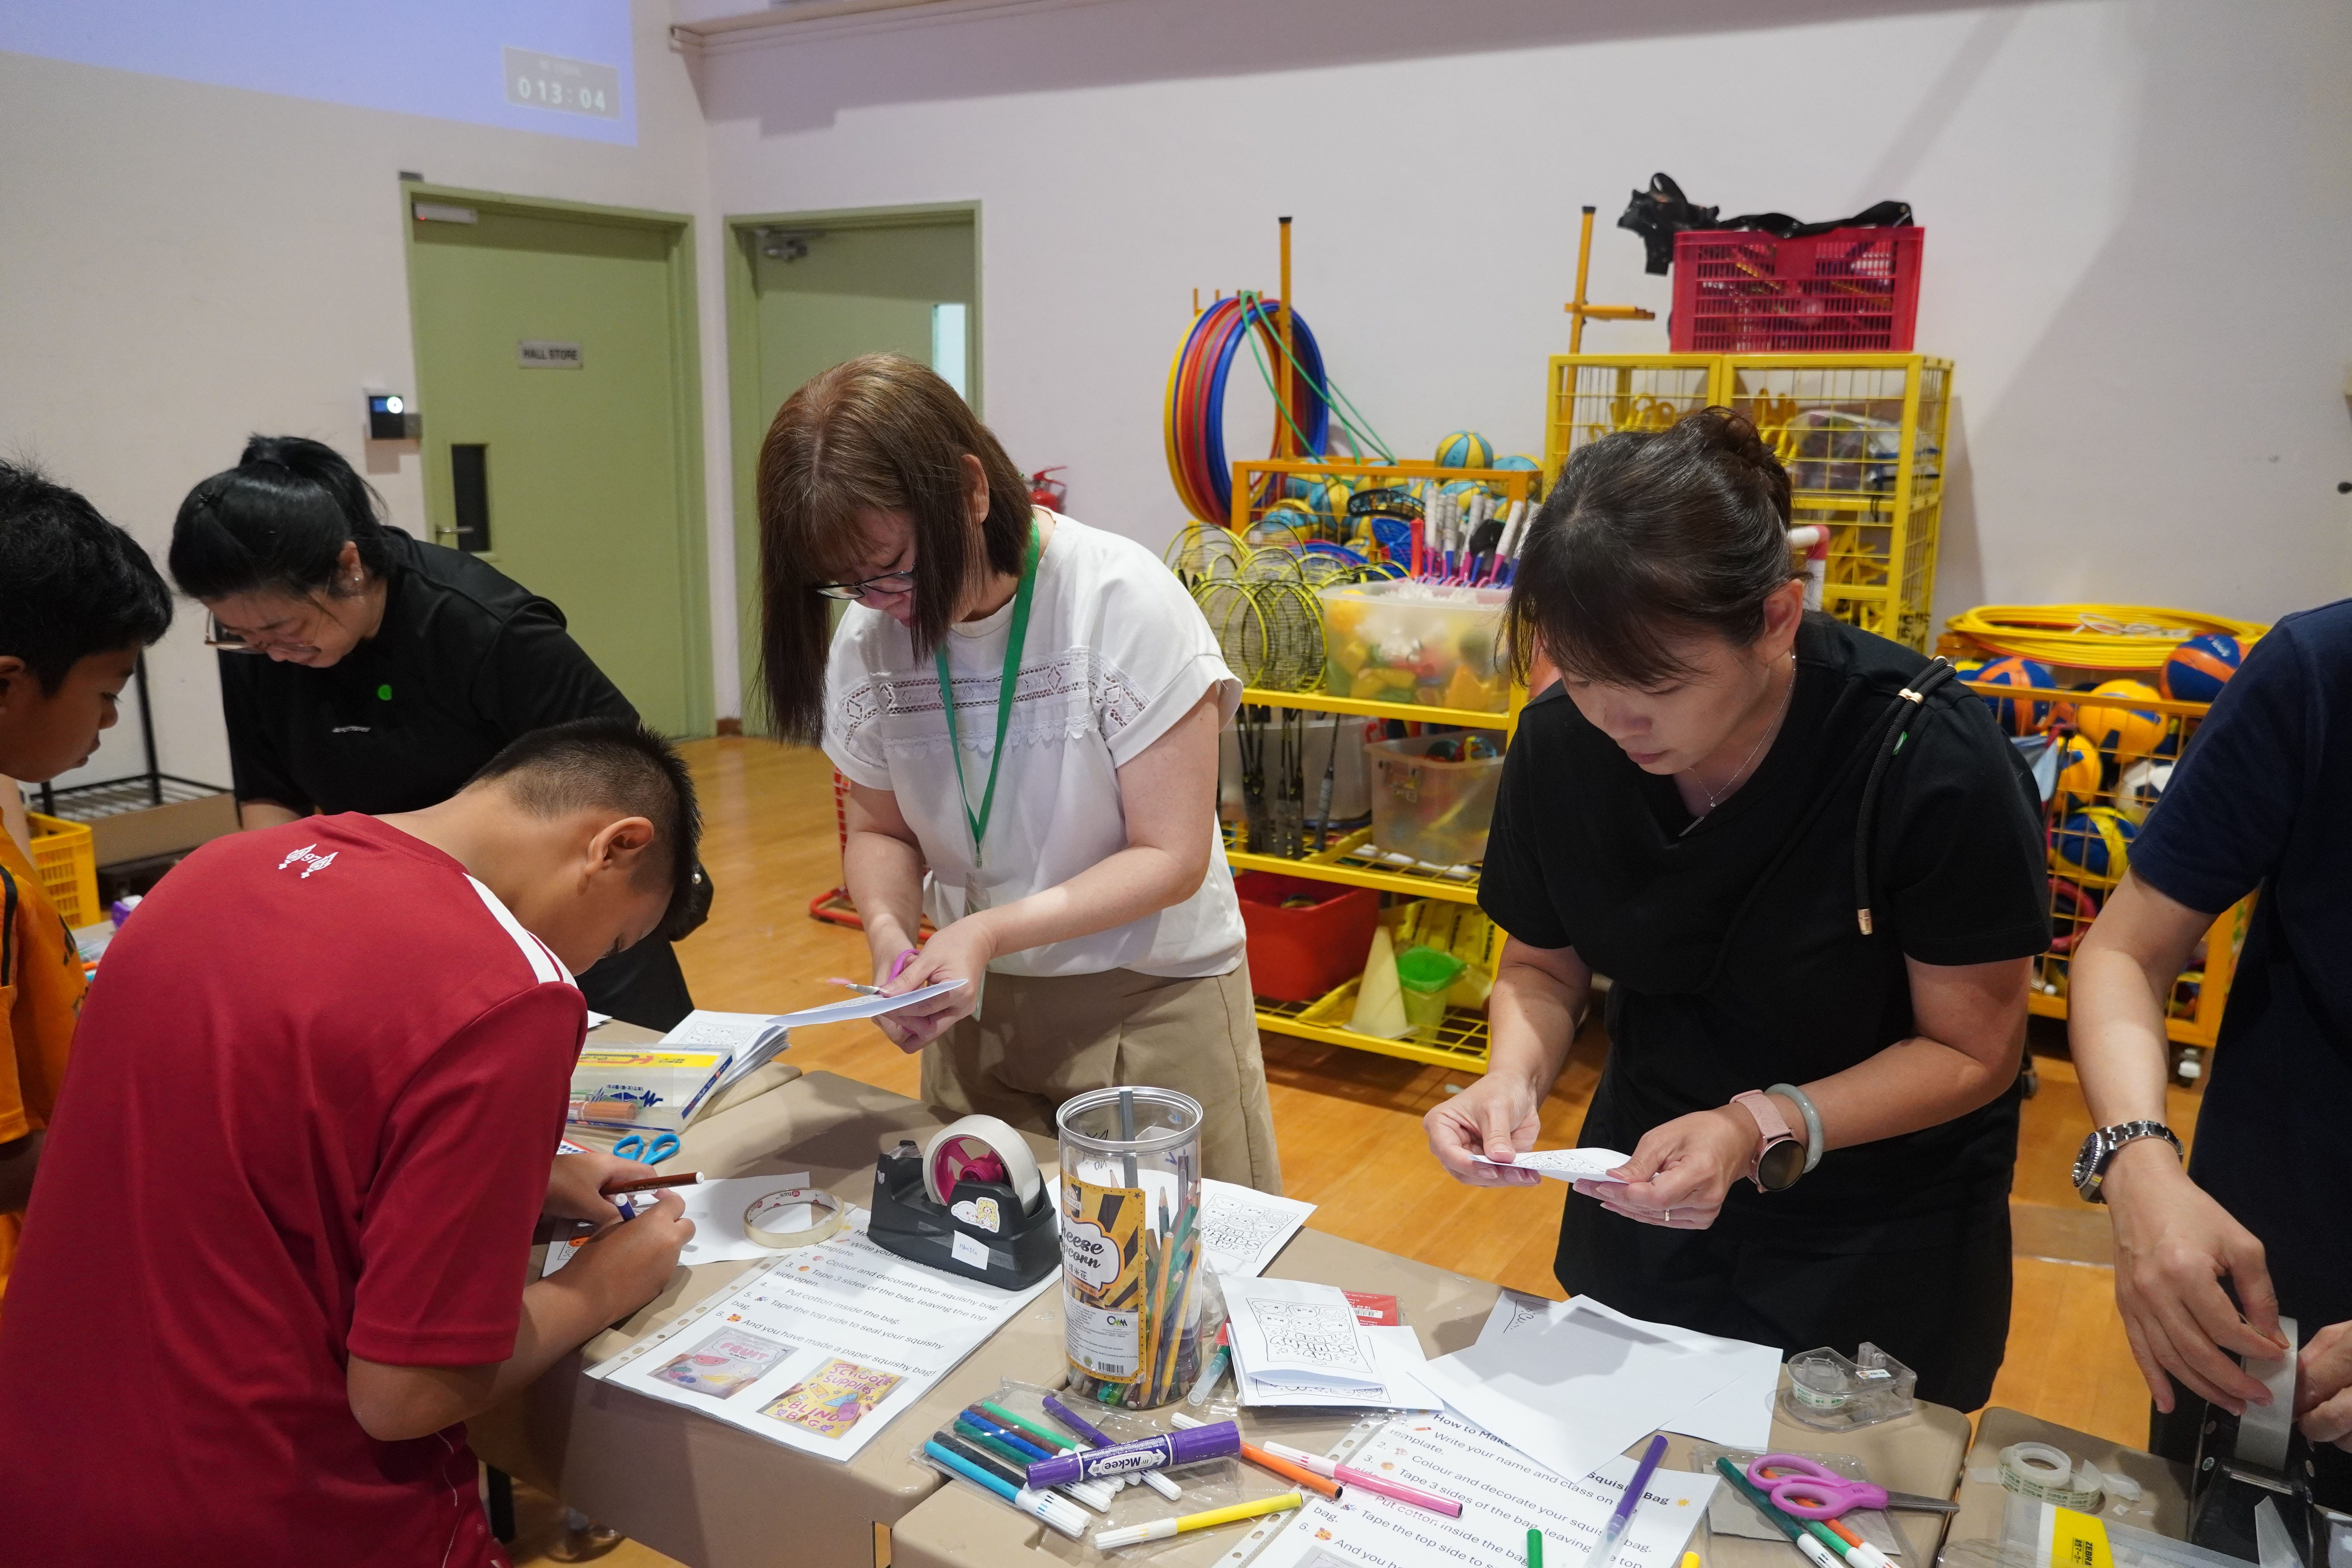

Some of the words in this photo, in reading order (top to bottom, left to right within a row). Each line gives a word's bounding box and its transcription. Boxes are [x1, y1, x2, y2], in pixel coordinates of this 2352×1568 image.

[524, 349, 547, 359] HALL
[549, 349, 577, 360] STORE
[301, 854, 322, 863] 97
[1062, 1220, 1104, 1255] heese
[814, 1243, 854, 1257] template.
[851, 1241, 874, 1251] Write
[873, 1248, 895, 1258] your
[774, 1271, 794, 1279] side
[795, 1277, 818, 1287] open.
[826, 1259, 857, 1271] Colour
[858, 1268, 878, 1277] and
[877, 1273, 917, 1289] decorate
[918, 1286, 940, 1294] your
[941, 1293, 978, 1305] squishy
[979, 1302, 998, 1311] bag.
[812, 1269, 833, 1279] Tape
[842, 1278, 866, 1289] sides
[895, 1293, 914, 1303] bag,
[917, 1299, 952, 1313] leaving
[731, 1300, 750, 1310] bag.
[785, 1289, 802, 1297] Put
[802, 1294, 833, 1306] cotton
[833, 1303, 862, 1314] inside
[864, 1310, 880, 1319] the
[880, 1316, 900, 1325] bag.
[771, 1300, 792, 1310] Tape
[810, 1311, 826, 1319] top
[827, 1316, 848, 1325] side
[860, 1325, 883, 1334] seal
[880, 1331, 905, 1340] your
[905, 1337, 945, 1350] squishy
[741, 1320, 763, 1329] And
[780, 1331, 804, 1341] have
[804, 1338, 833, 1350] made
[840, 1348, 872, 1360] paper
[872, 1356, 912, 1371] squishy
[913, 1367, 936, 1376] bag!
[1270, 1336, 1357, 1356] Squishy
[1296, 1333, 1326, 1343] Bag
[720, 1342, 769, 1360] FRUIT
[786, 1412, 820, 1427] BAG
[788, 1401, 840, 1421] BLIND
[1434, 1414, 1462, 1428] How
[1390, 1430, 1444, 1454] template.
[1435, 1432, 1465, 1448] Write
[1466, 1446, 1495, 1458] your
[1496, 1456, 1531, 1473] name
[1534, 1470, 1558, 1483] and
[1560, 1481, 1594, 1498] class
[1597, 1495, 1613, 1505] on
[1376, 1441, 1386, 1450] 2.
[1412, 1455, 1453, 1476] Colour
[1455, 1474, 1480, 1486] and
[1481, 1484, 1536, 1509] decorate
[1537, 1506, 1569, 1521] your
[1570, 1519, 1607, 1537] squis
[1624, 1539, 1651, 1553] bag.
[1643, 1492, 1670, 1505] Bag
[1314, 1506, 1338, 1522] bag.
[1399, 1469, 1427, 1485] Tape
[1439, 1487, 1473, 1503] sides
[1490, 1507, 1511, 1519] the
[1544, 1528, 1593, 1553] leaving
[1375, 1495, 1396, 1509] Put
[1397, 1506, 1437, 1526] cotton
[1440, 1523, 1479, 1543] inside
[1483, 1540, 1503, 1553] the
[1299, 1523, 1308, 1532] 6.
[1334, 1540, 1361, 1554] And
[1360, 1552, 1386, 1566] you
[1361, 1510, 1390, 1527] Tape
[1393, 1524, 1412, 1537] the
[1416, 1534, 1436, 1546] top
[1439, 1545, 1466, 1559] side
[1470, 1557, 1482, 1566] to
[1619, 1558, 1642, 1568] top
[2084, 1541, 2092, 1565] ZEBRA
